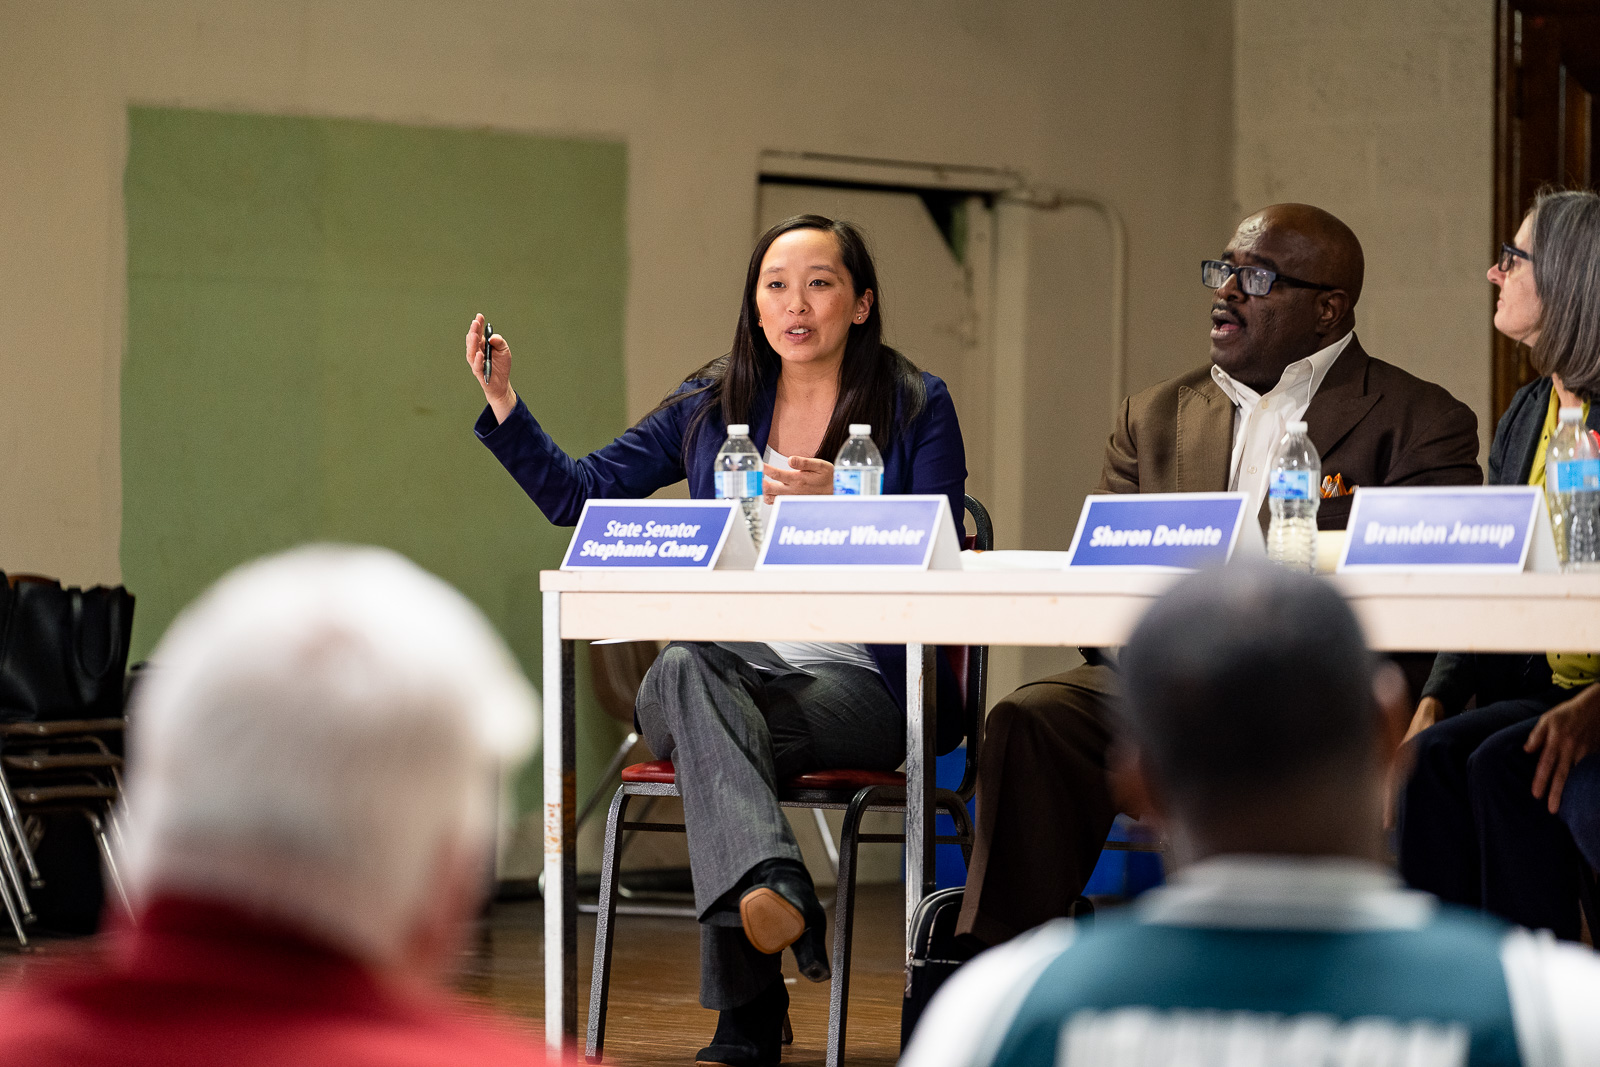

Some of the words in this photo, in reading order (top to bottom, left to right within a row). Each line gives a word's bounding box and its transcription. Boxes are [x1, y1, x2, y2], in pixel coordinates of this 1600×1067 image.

[603, 520, 642, 538] State
[642, 520, 701, 538] Senator
[778, 525, 849, 546] Heaster
[850, 524, 925, 546] Wheeler
[1089, 524, 1152, 547] Sharon
[1152, 523, 1222, 547] Dolente
[1364, 520, 1447, 545] Brandon
[1447, 520, 1515, 549] Jessup
[580, 540, 658, 561] Stephanie
[658, 540, 709, 562] Chang
